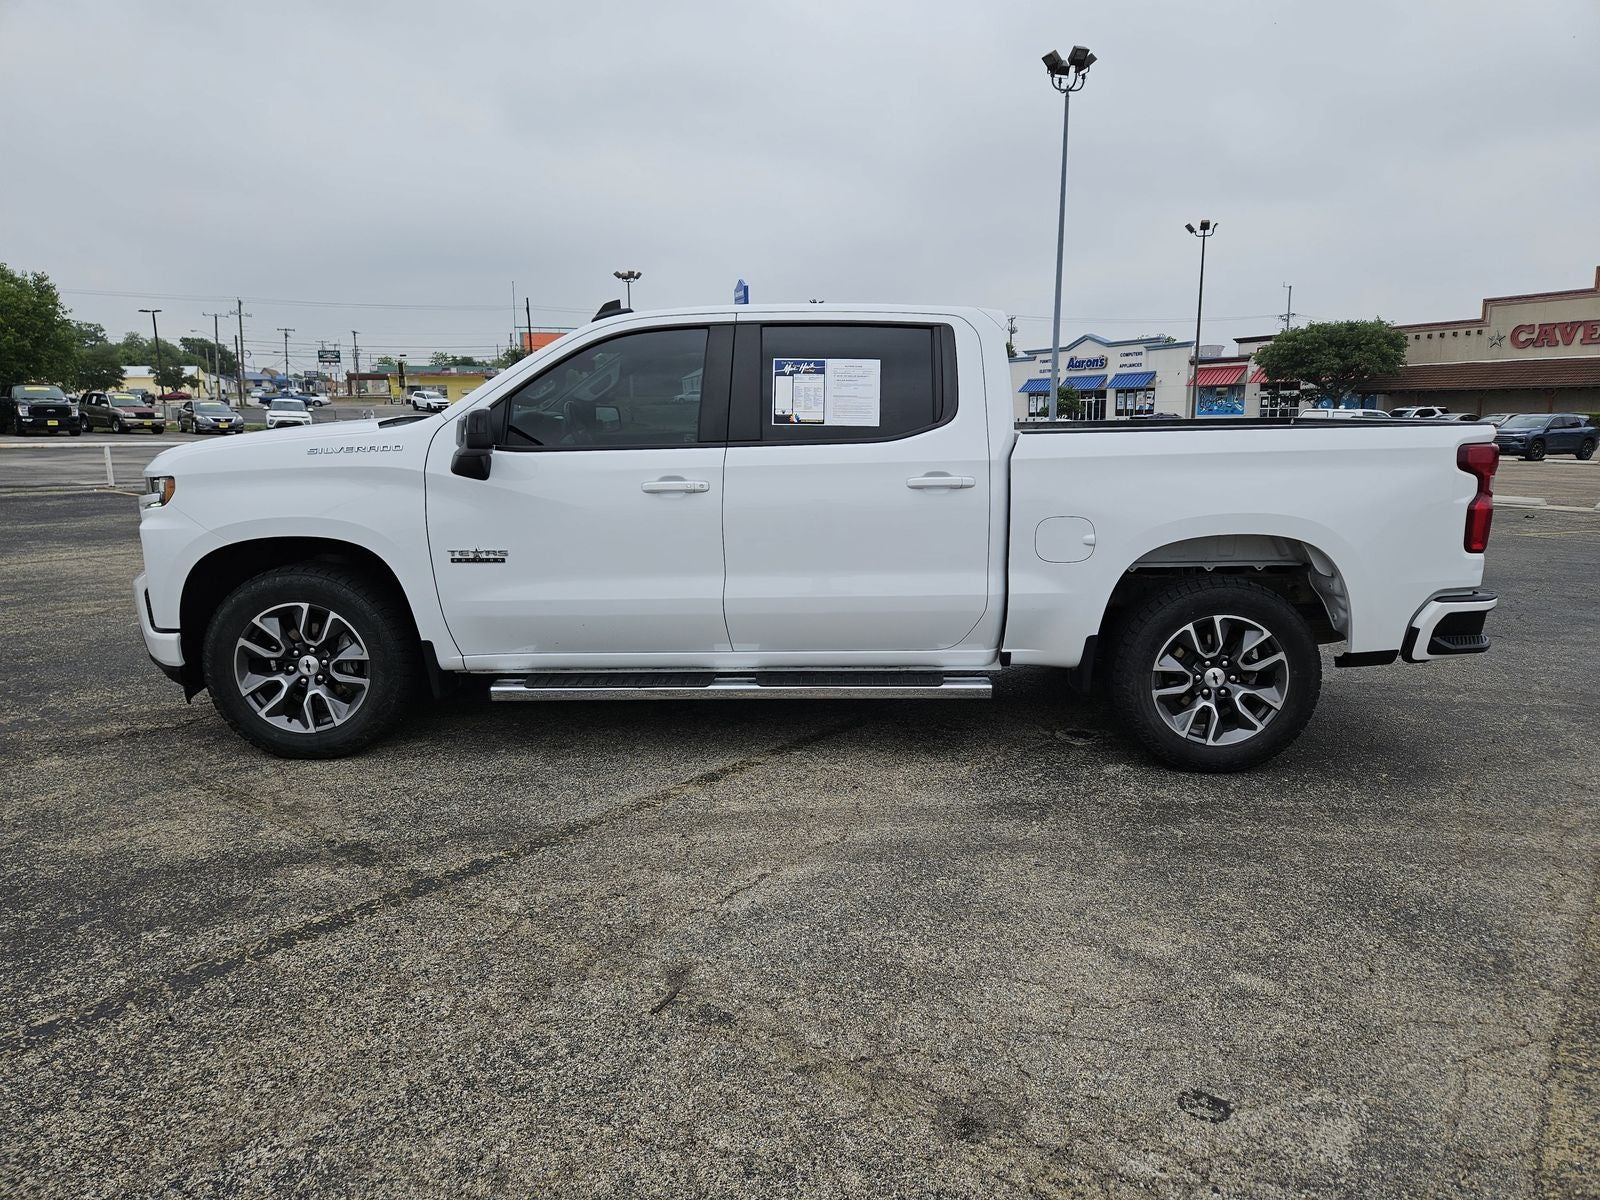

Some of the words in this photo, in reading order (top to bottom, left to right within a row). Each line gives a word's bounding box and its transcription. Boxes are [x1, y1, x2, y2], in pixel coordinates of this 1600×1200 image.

[1510, 320, 1600, 349] CAVE
[1066, 356, 1106, 369] Aaron's
[307, 445, 404, 455] SILVERADO
[447, 547, 508, 557] TEXAS
